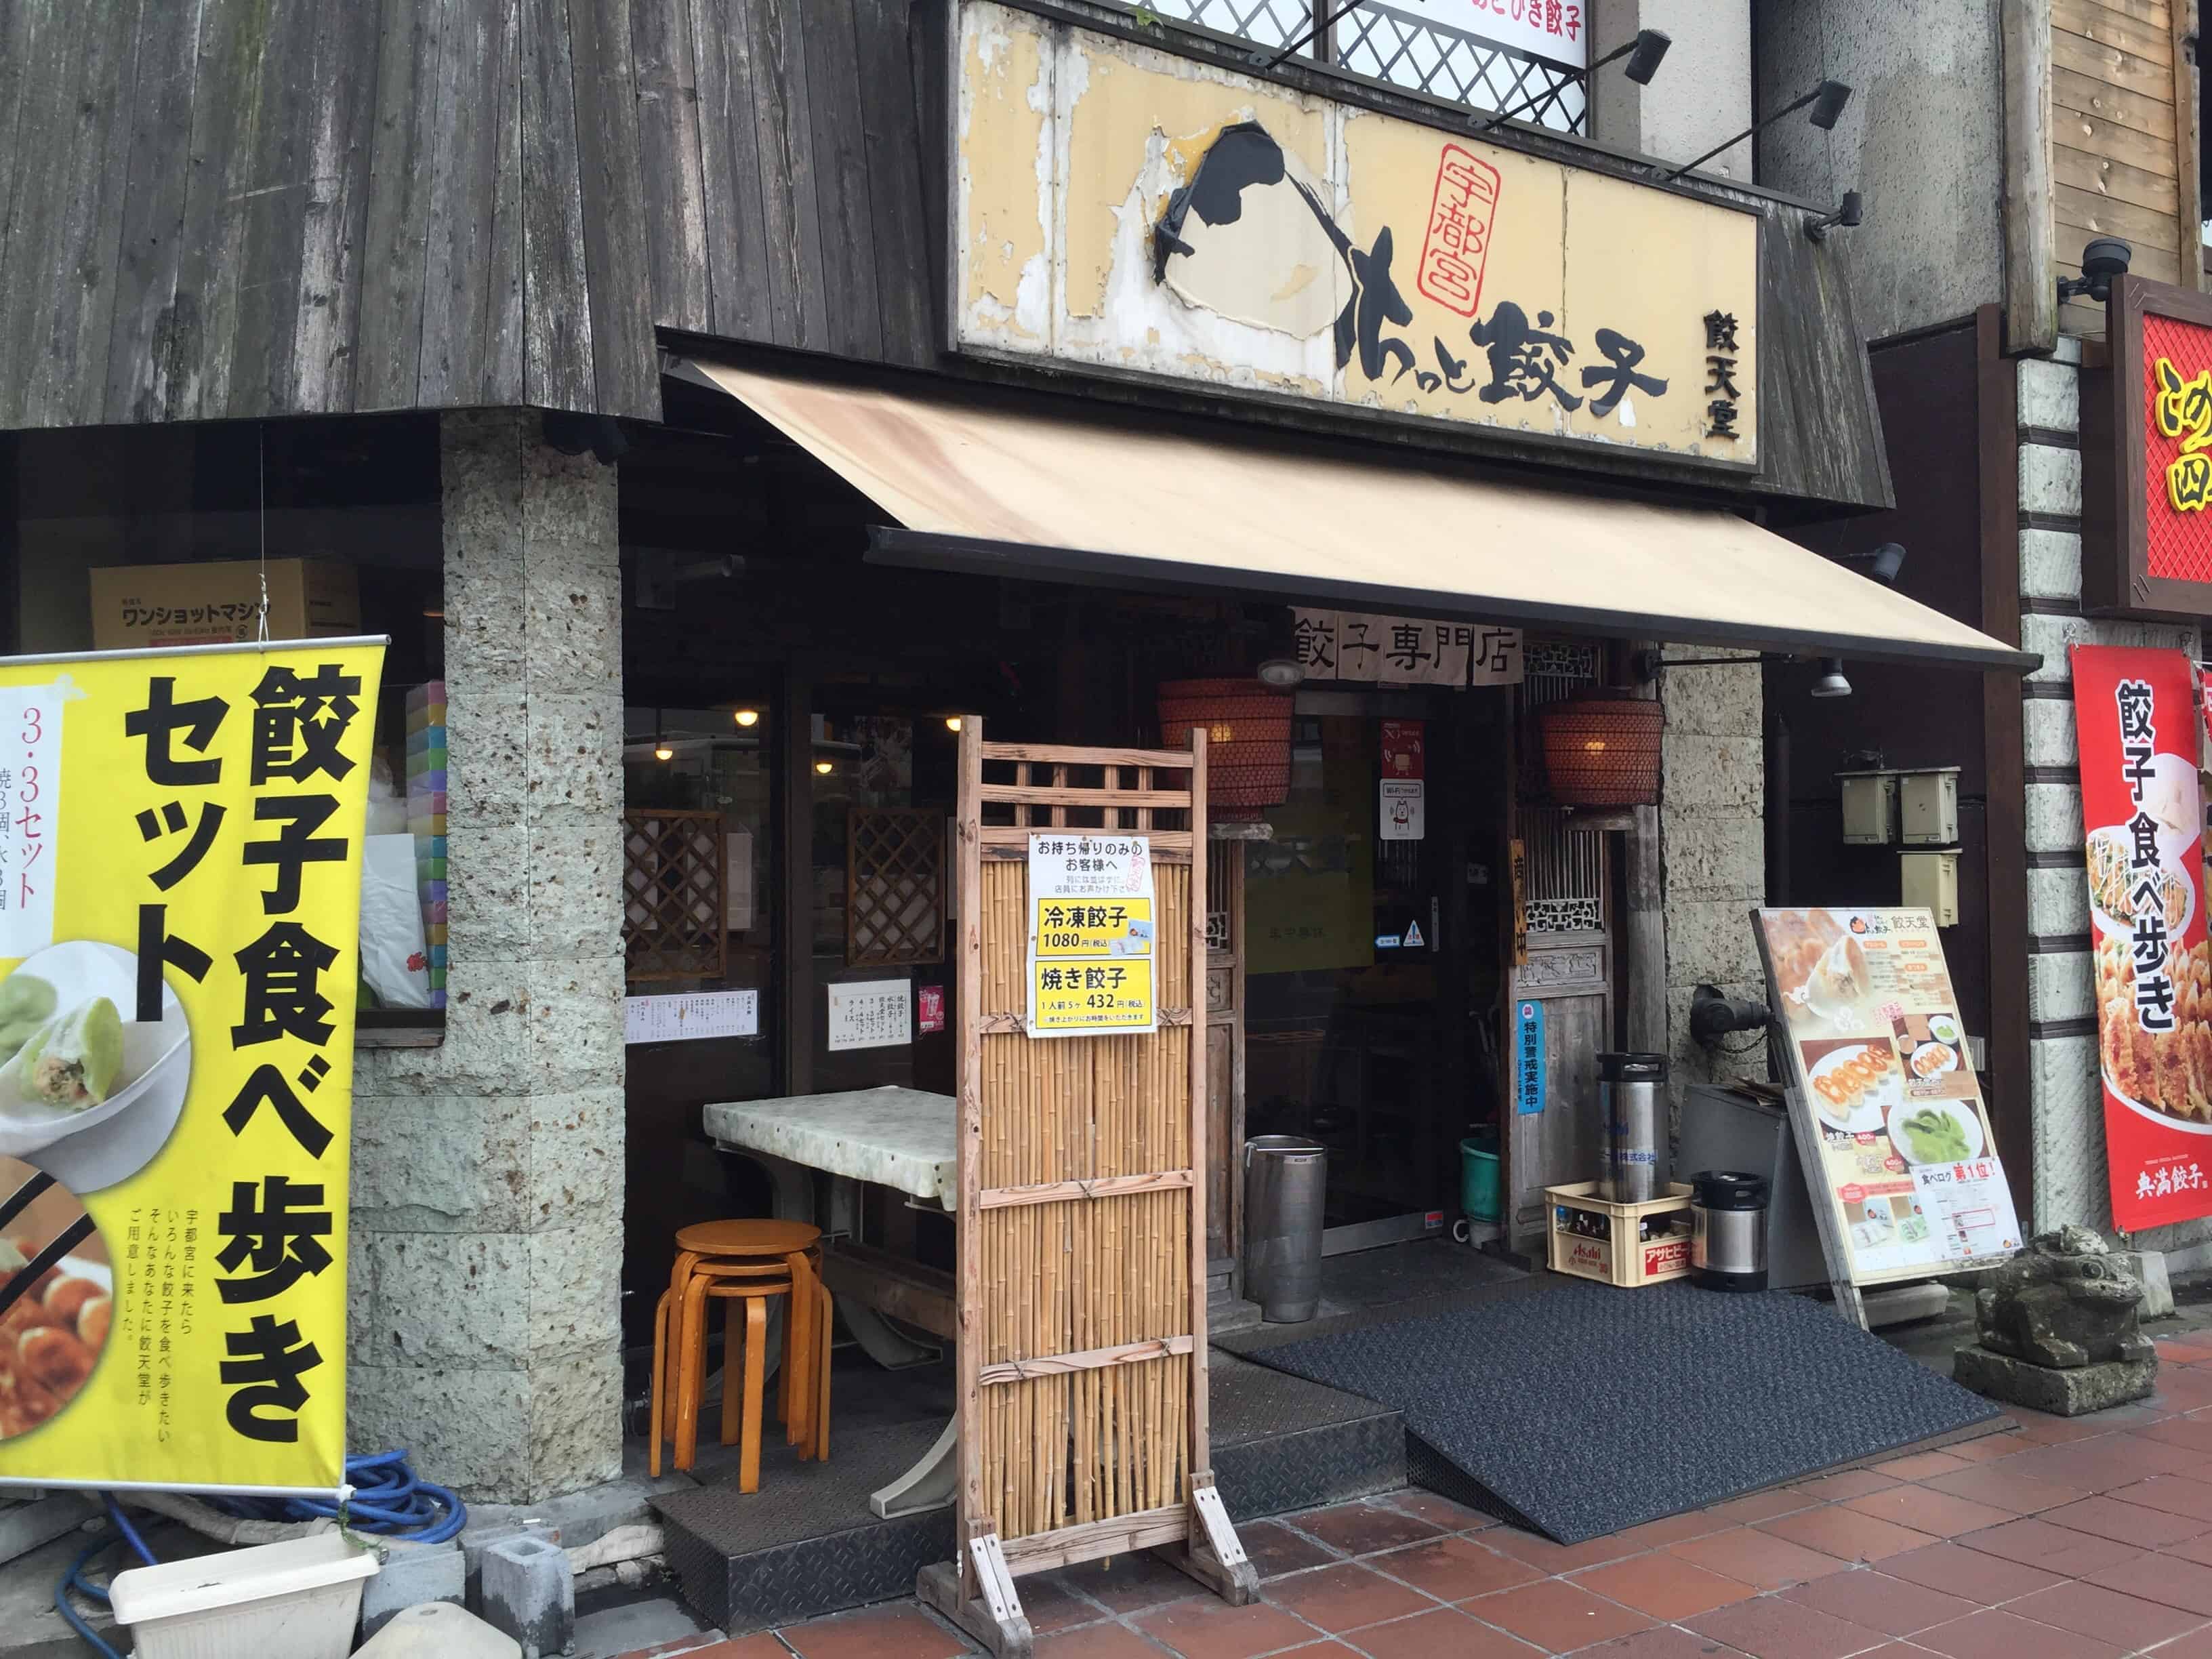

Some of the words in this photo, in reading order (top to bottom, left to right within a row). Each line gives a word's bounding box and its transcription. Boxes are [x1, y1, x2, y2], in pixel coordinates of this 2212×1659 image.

[1429, 162, 1492, 301] 宇都宮
[1704, 308, 1742, 440] 餃天堂
[1294, 617, 1517, 673] 餃子専門店
[125, 676, 230, 1023] セット
[1038, 840, 1143, 856] お持ち帰りのみの
[1066, 858, 1118, 872] お客様へ
[2117, 683, 2174, 1029] 餃子食べ歩き
[1041, 967, 1127, 990] 焼き餃子
[1044, 905, 1128, 928] 冷凍餃子
[215, 663, 362, 1443] 餃子食べ歩き
[1524, 1021, 1538, 1107] 特別警戒実施中
[1922, 1172, 1952, 1185] 食べログ
[123, 1208, 142, 1341] ご用意しました。
[138, 1208, 161, 1406] そんなあなたに餃天堂が
[180, 1209, 199, 1334] 宇都宮に来たら
[1574, 1242, 1601, 1261] Asahi
[158, 1210, 180, 1442] いろんな餃子を食べ歩きたい
